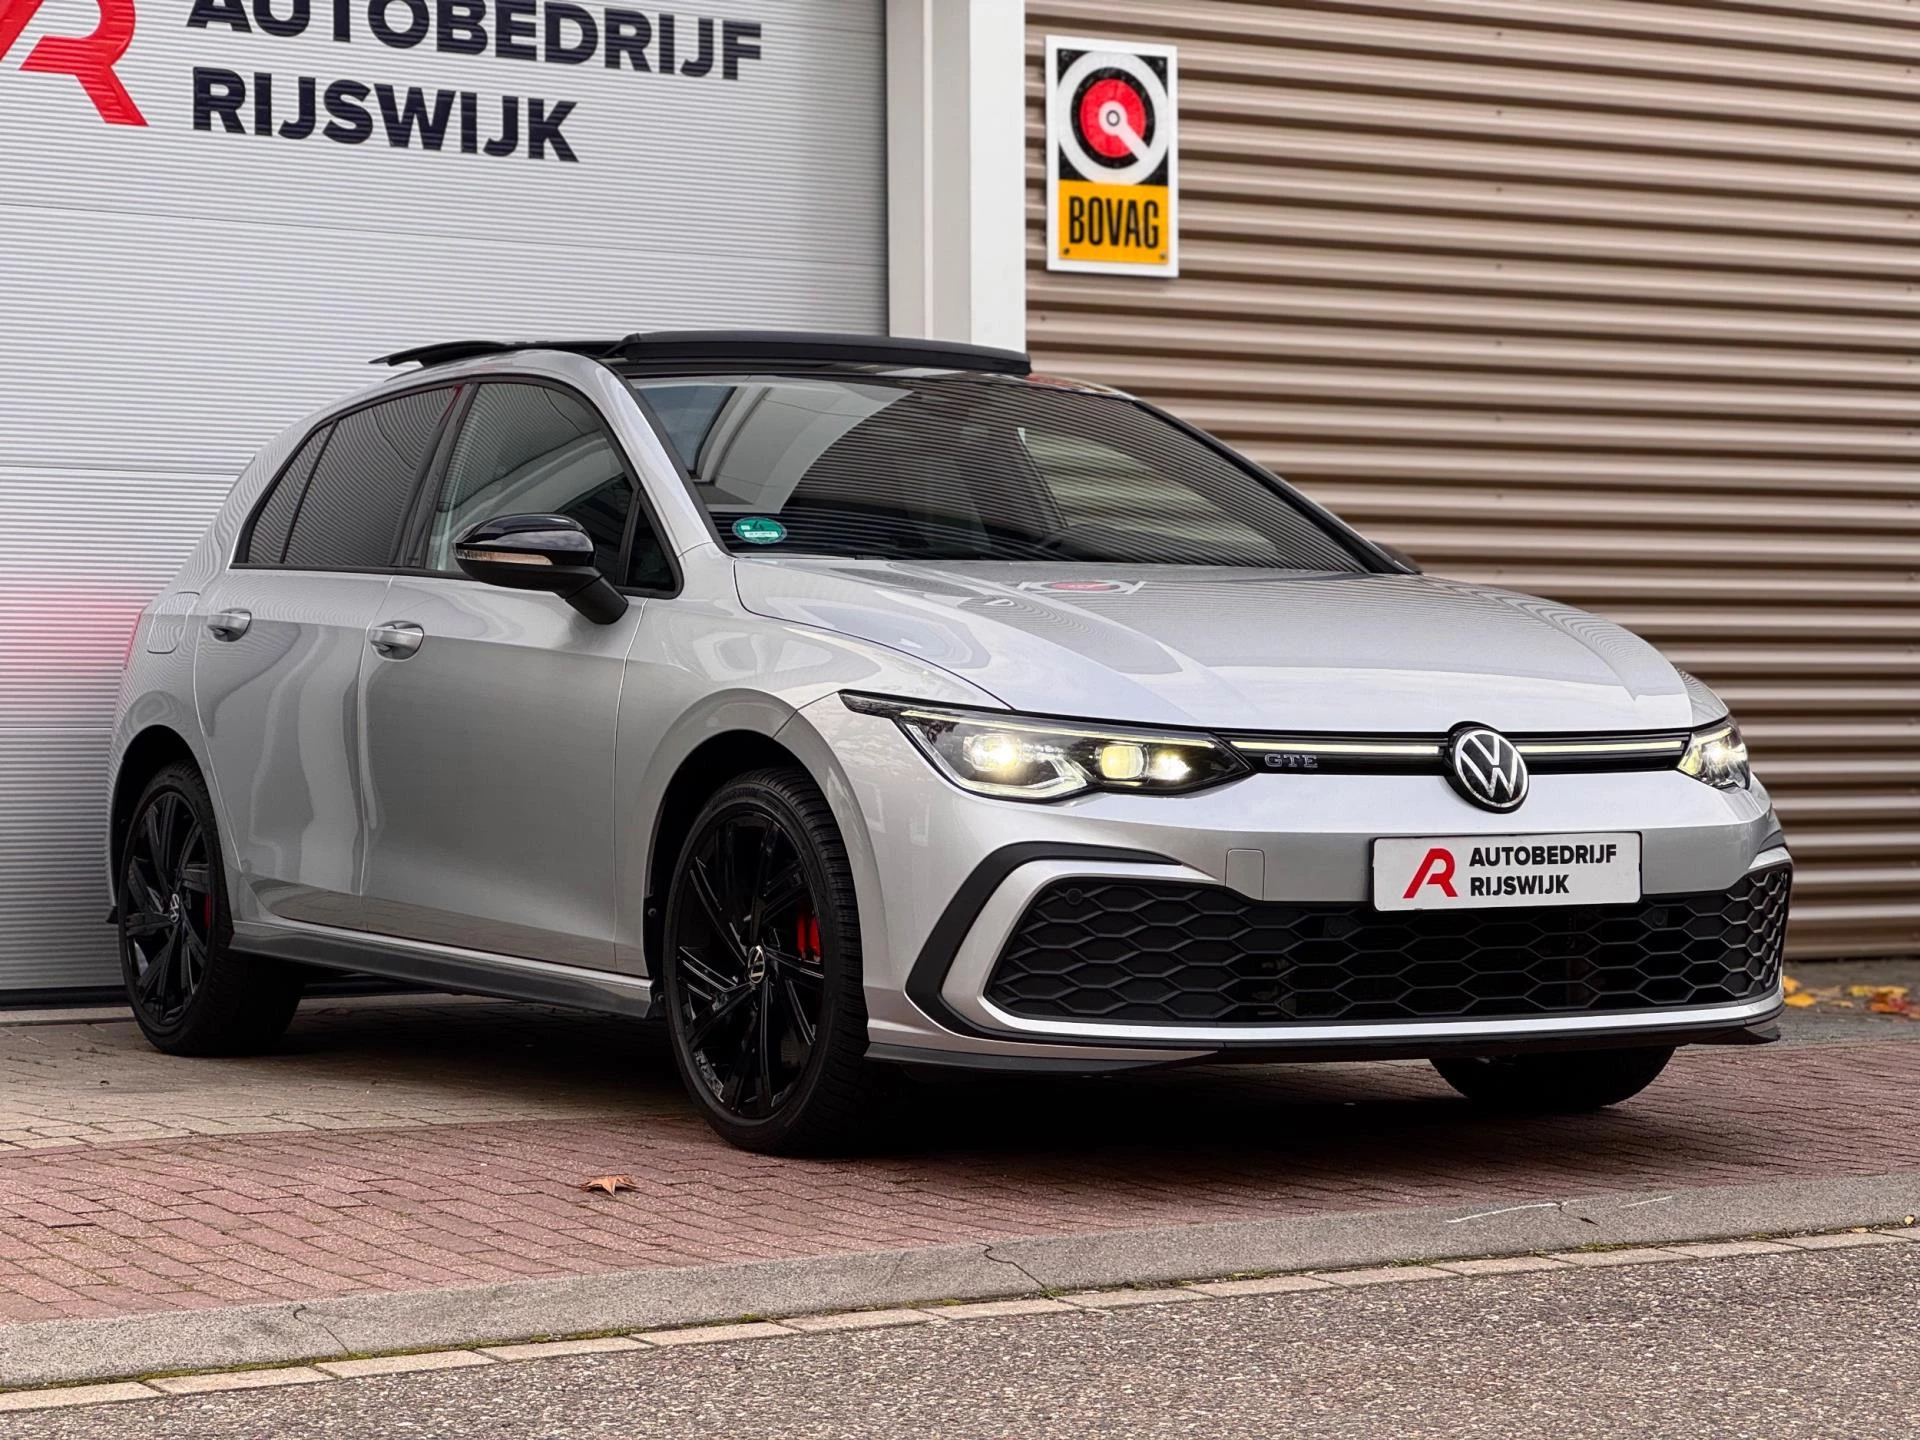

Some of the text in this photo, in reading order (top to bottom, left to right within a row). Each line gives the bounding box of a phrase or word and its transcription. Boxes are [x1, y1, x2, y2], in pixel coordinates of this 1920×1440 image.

[193, 66, 579, 163] RIJSWIJK
[1069, 196, 1159, 249] BOVAG
[1264, 753, 1318, 768] GTE
[1469, 844, 1617, 867] AUTOBEDRIJF
[1470, 874, 1570, 896] RIJSWIJK
